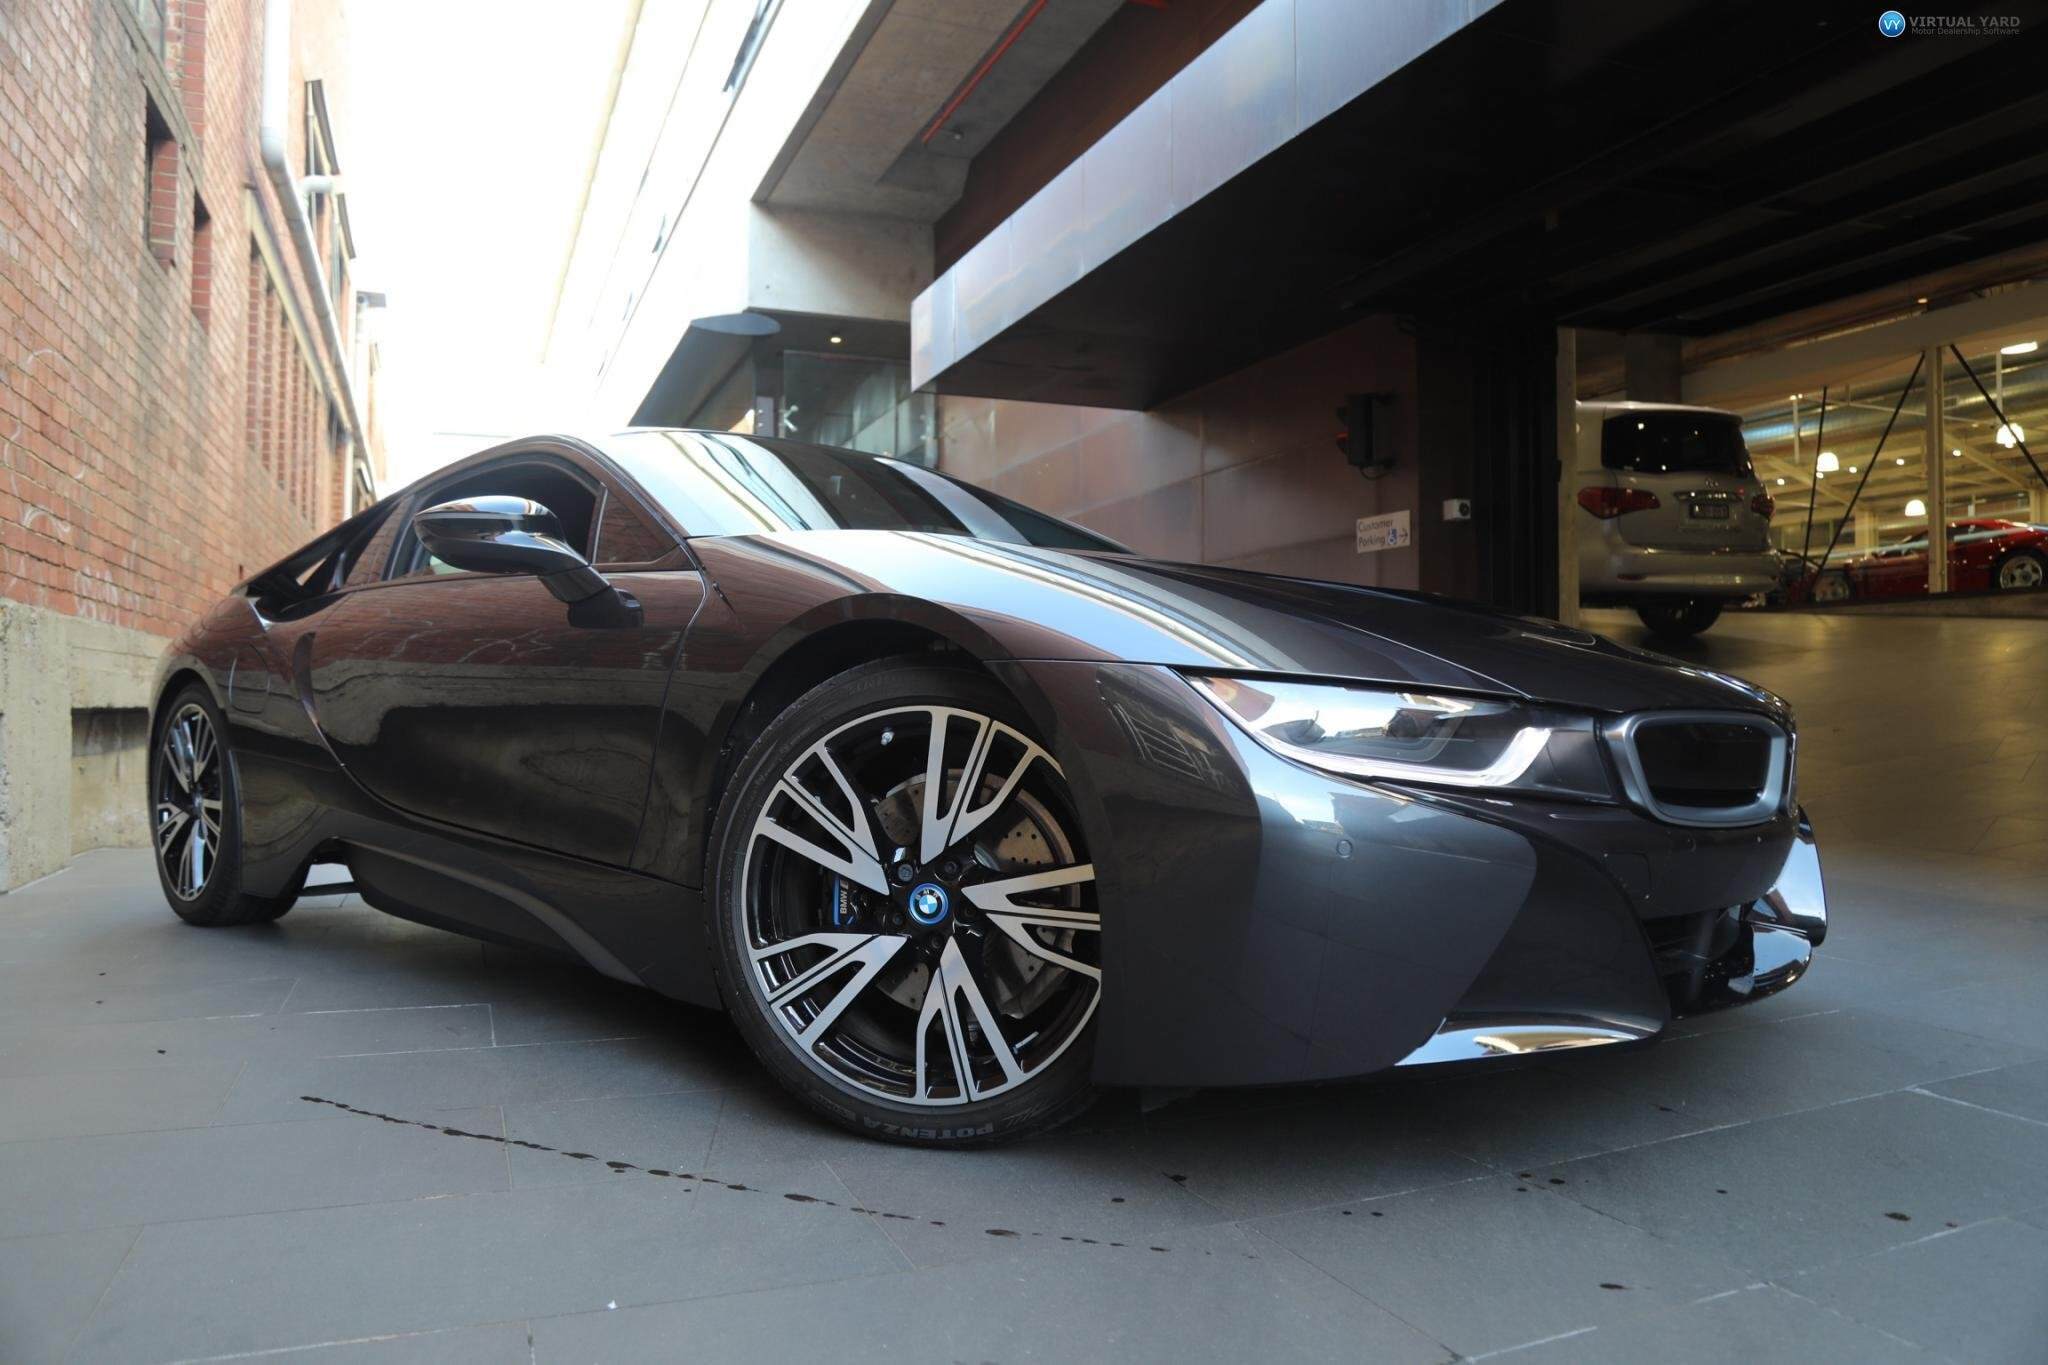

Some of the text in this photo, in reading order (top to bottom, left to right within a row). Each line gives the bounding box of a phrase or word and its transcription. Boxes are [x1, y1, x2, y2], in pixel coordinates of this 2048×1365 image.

[1358, 519, 1394, 531] Customer
[1358, 535, 1386, 547] Parking
[840, 890, 848, 915] BMW
[864, 1116, 994, 1140] POTENZA
